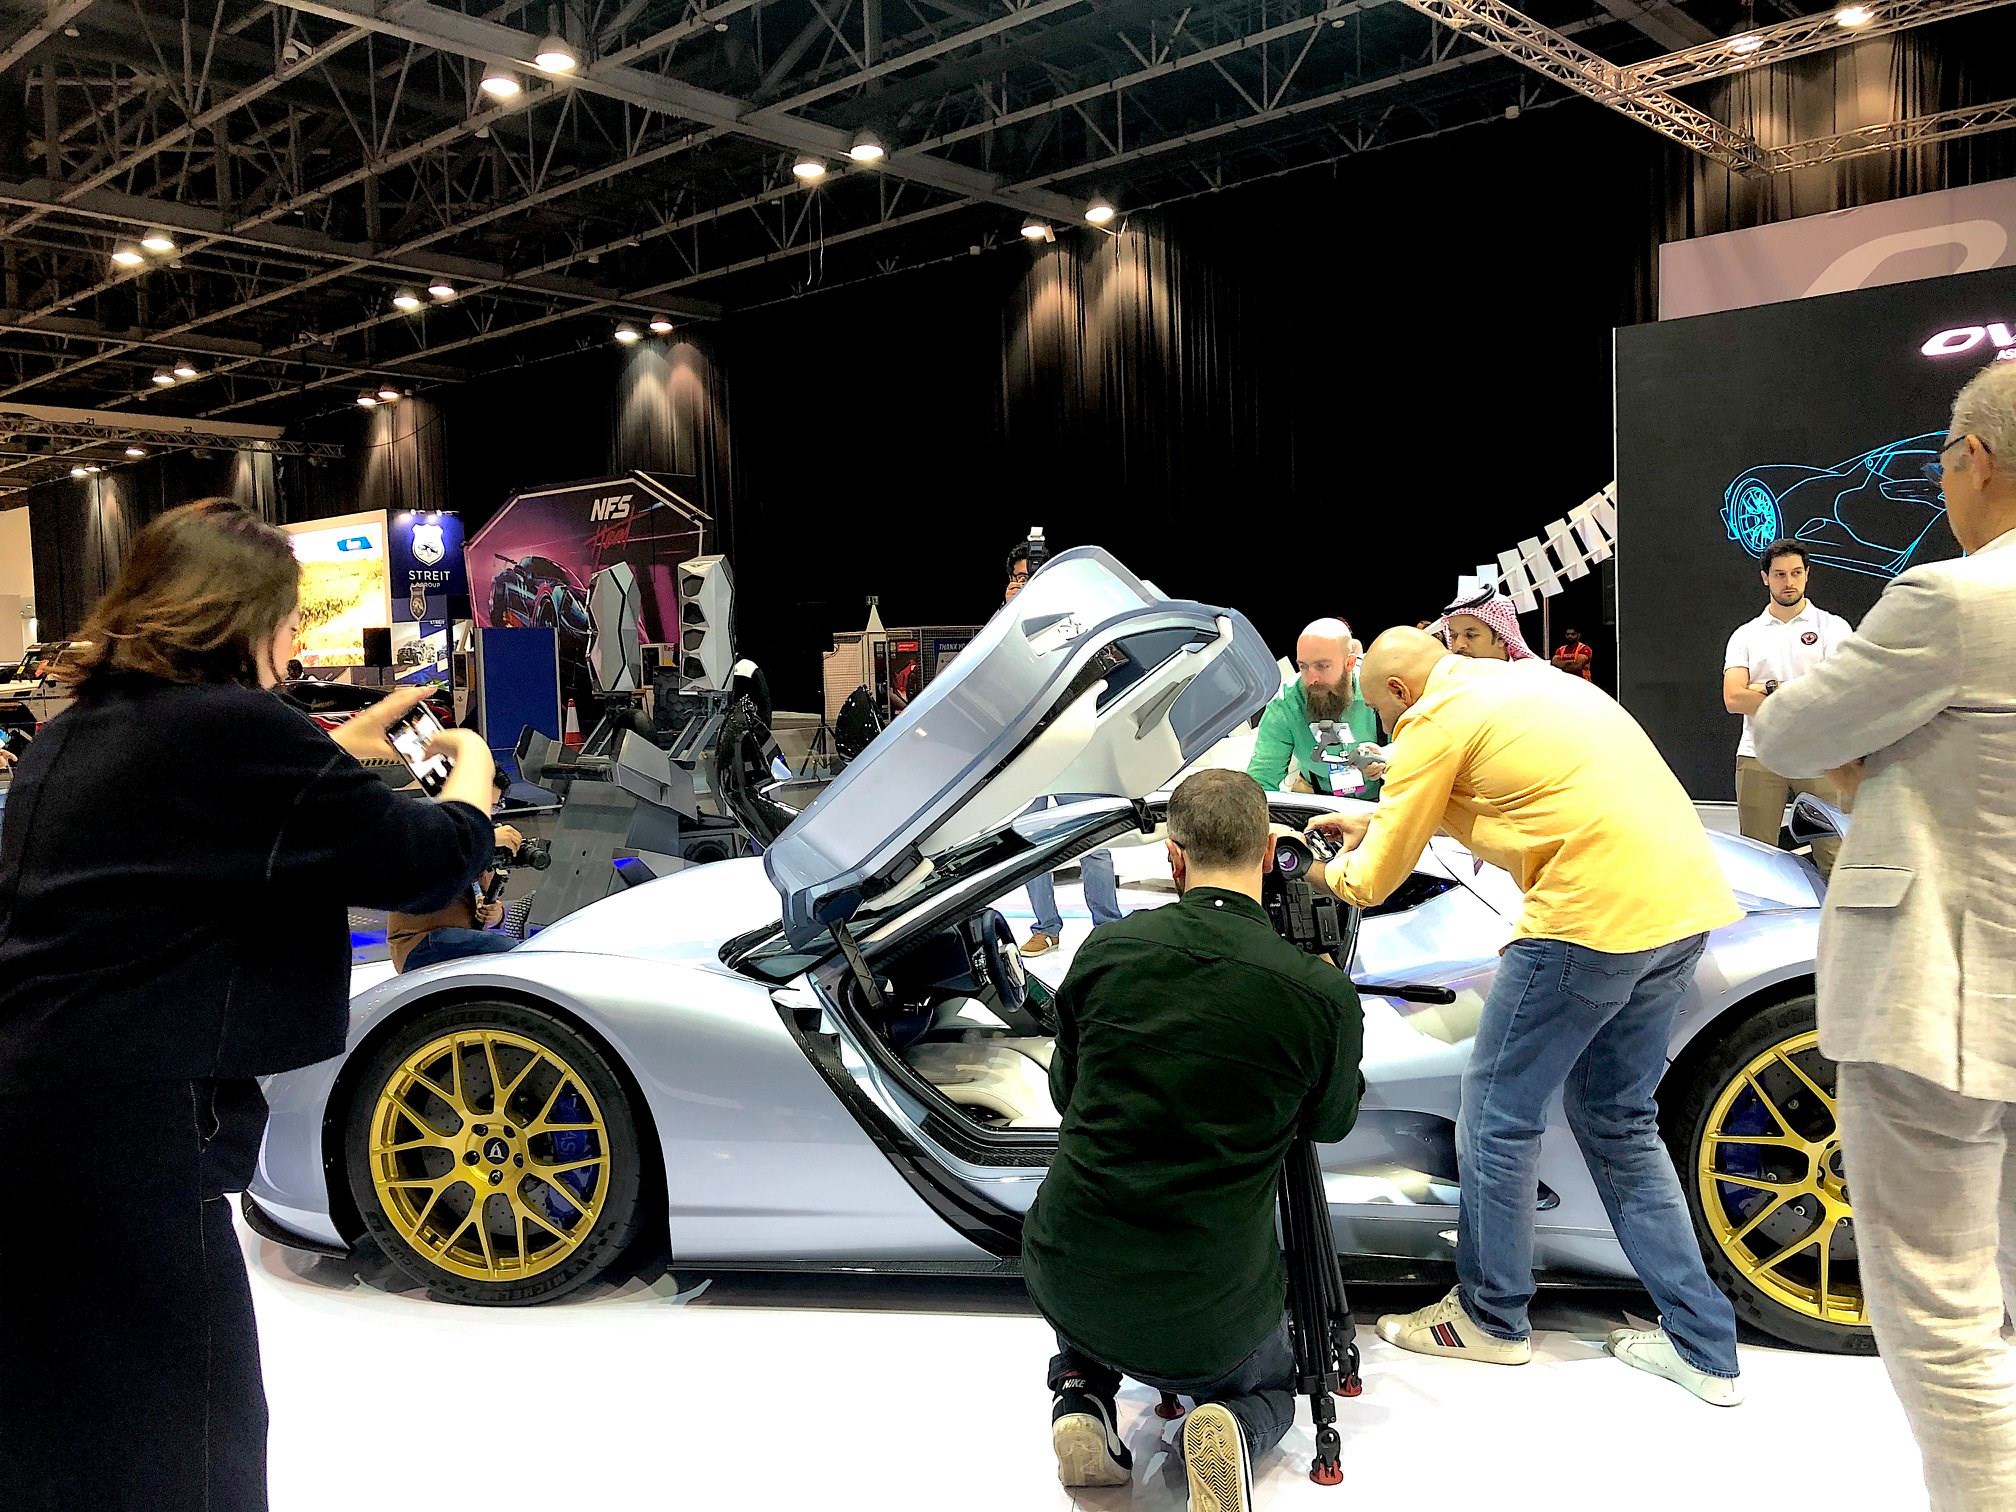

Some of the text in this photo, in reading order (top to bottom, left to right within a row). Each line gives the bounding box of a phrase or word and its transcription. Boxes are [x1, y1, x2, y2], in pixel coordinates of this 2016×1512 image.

[590, 494, 634, 522] NFS
[408, 570, 451, 581] STREIT
[1062, 1378, 1087, 1390] NIKE
